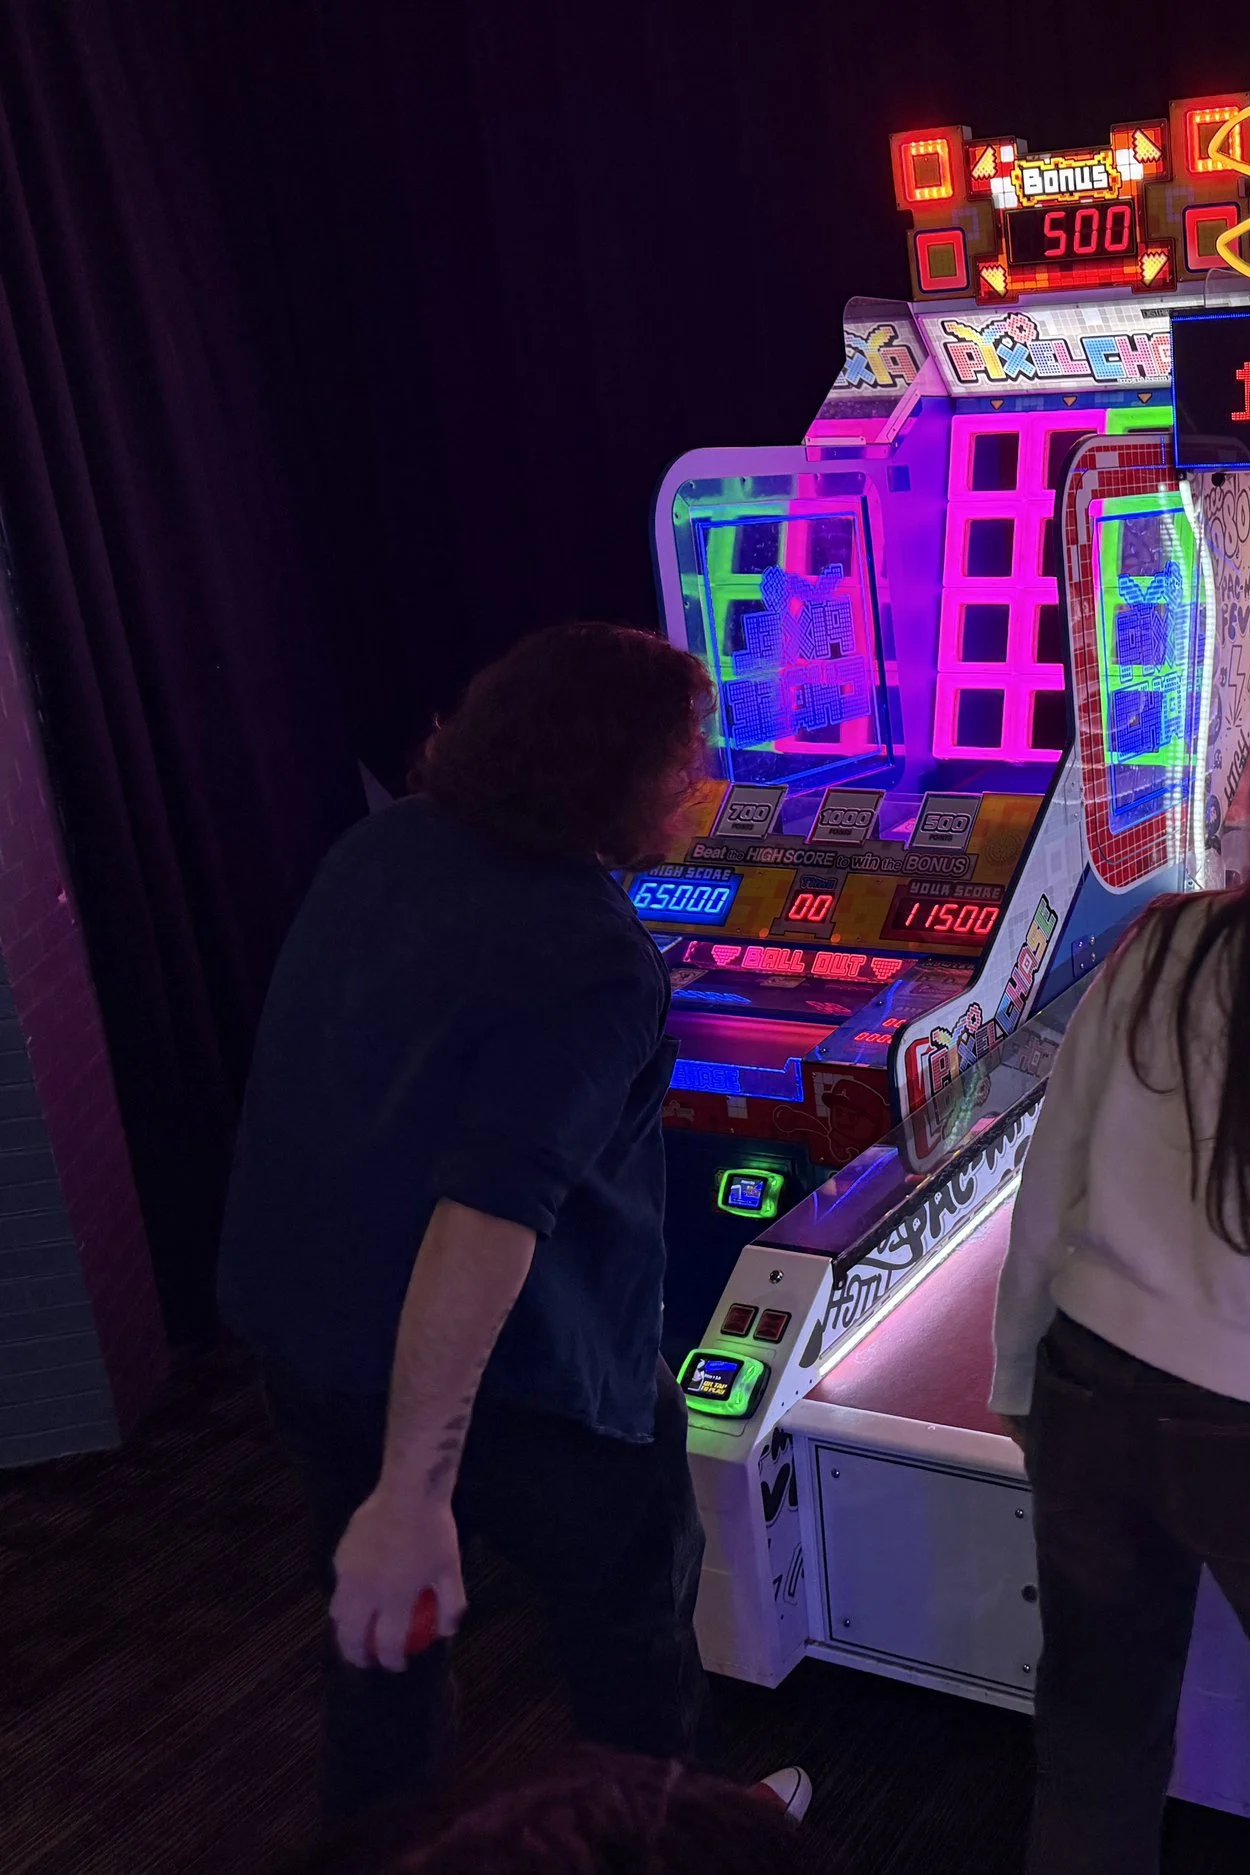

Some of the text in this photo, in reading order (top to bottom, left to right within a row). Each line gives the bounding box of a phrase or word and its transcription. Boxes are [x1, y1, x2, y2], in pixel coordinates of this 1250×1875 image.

[1044, 205, 1130, 257] 500
[943, 313, 1089, 383] PIXEL
[728, 804, 770, 822] 700
[819, 809, 872, 827] 1000
[922, 815, 969, 832] 500
[685, 866, 732, 881] SCORE
[692, 844, 726, 860] Beat
[746, 847, 784, 863] HIGH
[784, 850, 835, 866] SCORE
[852, 853, 881, 871] win
[905, 856, 968, 875] BONUS
[633, 882, 730, 914] 65000
[909, 881, 1001, 899] YOUR SCORE
[788, 893, 833, 920] 00
[905, 902, 1000, 934] 11500
[741, 945, 867, 978] BALL OUT
